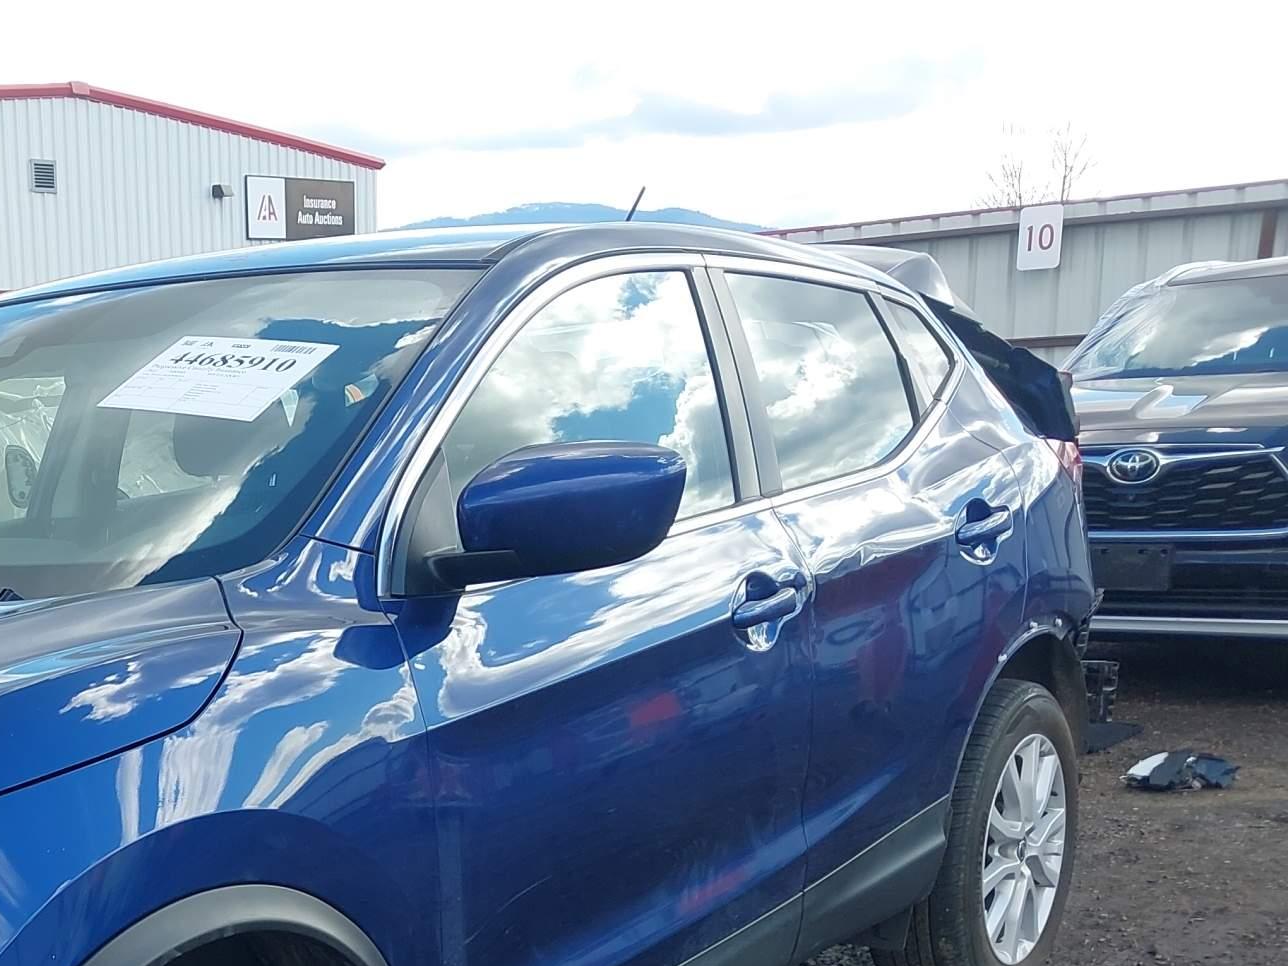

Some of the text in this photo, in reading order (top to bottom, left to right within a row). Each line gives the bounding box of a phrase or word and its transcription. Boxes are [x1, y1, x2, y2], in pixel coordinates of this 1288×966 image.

[303, 194, 337, 210] Insurance
[297, 210, 344, 226] Auto Auctions
[1024, 223, 1055, 252] 10
[170, 351, 298, 373] 44685910
